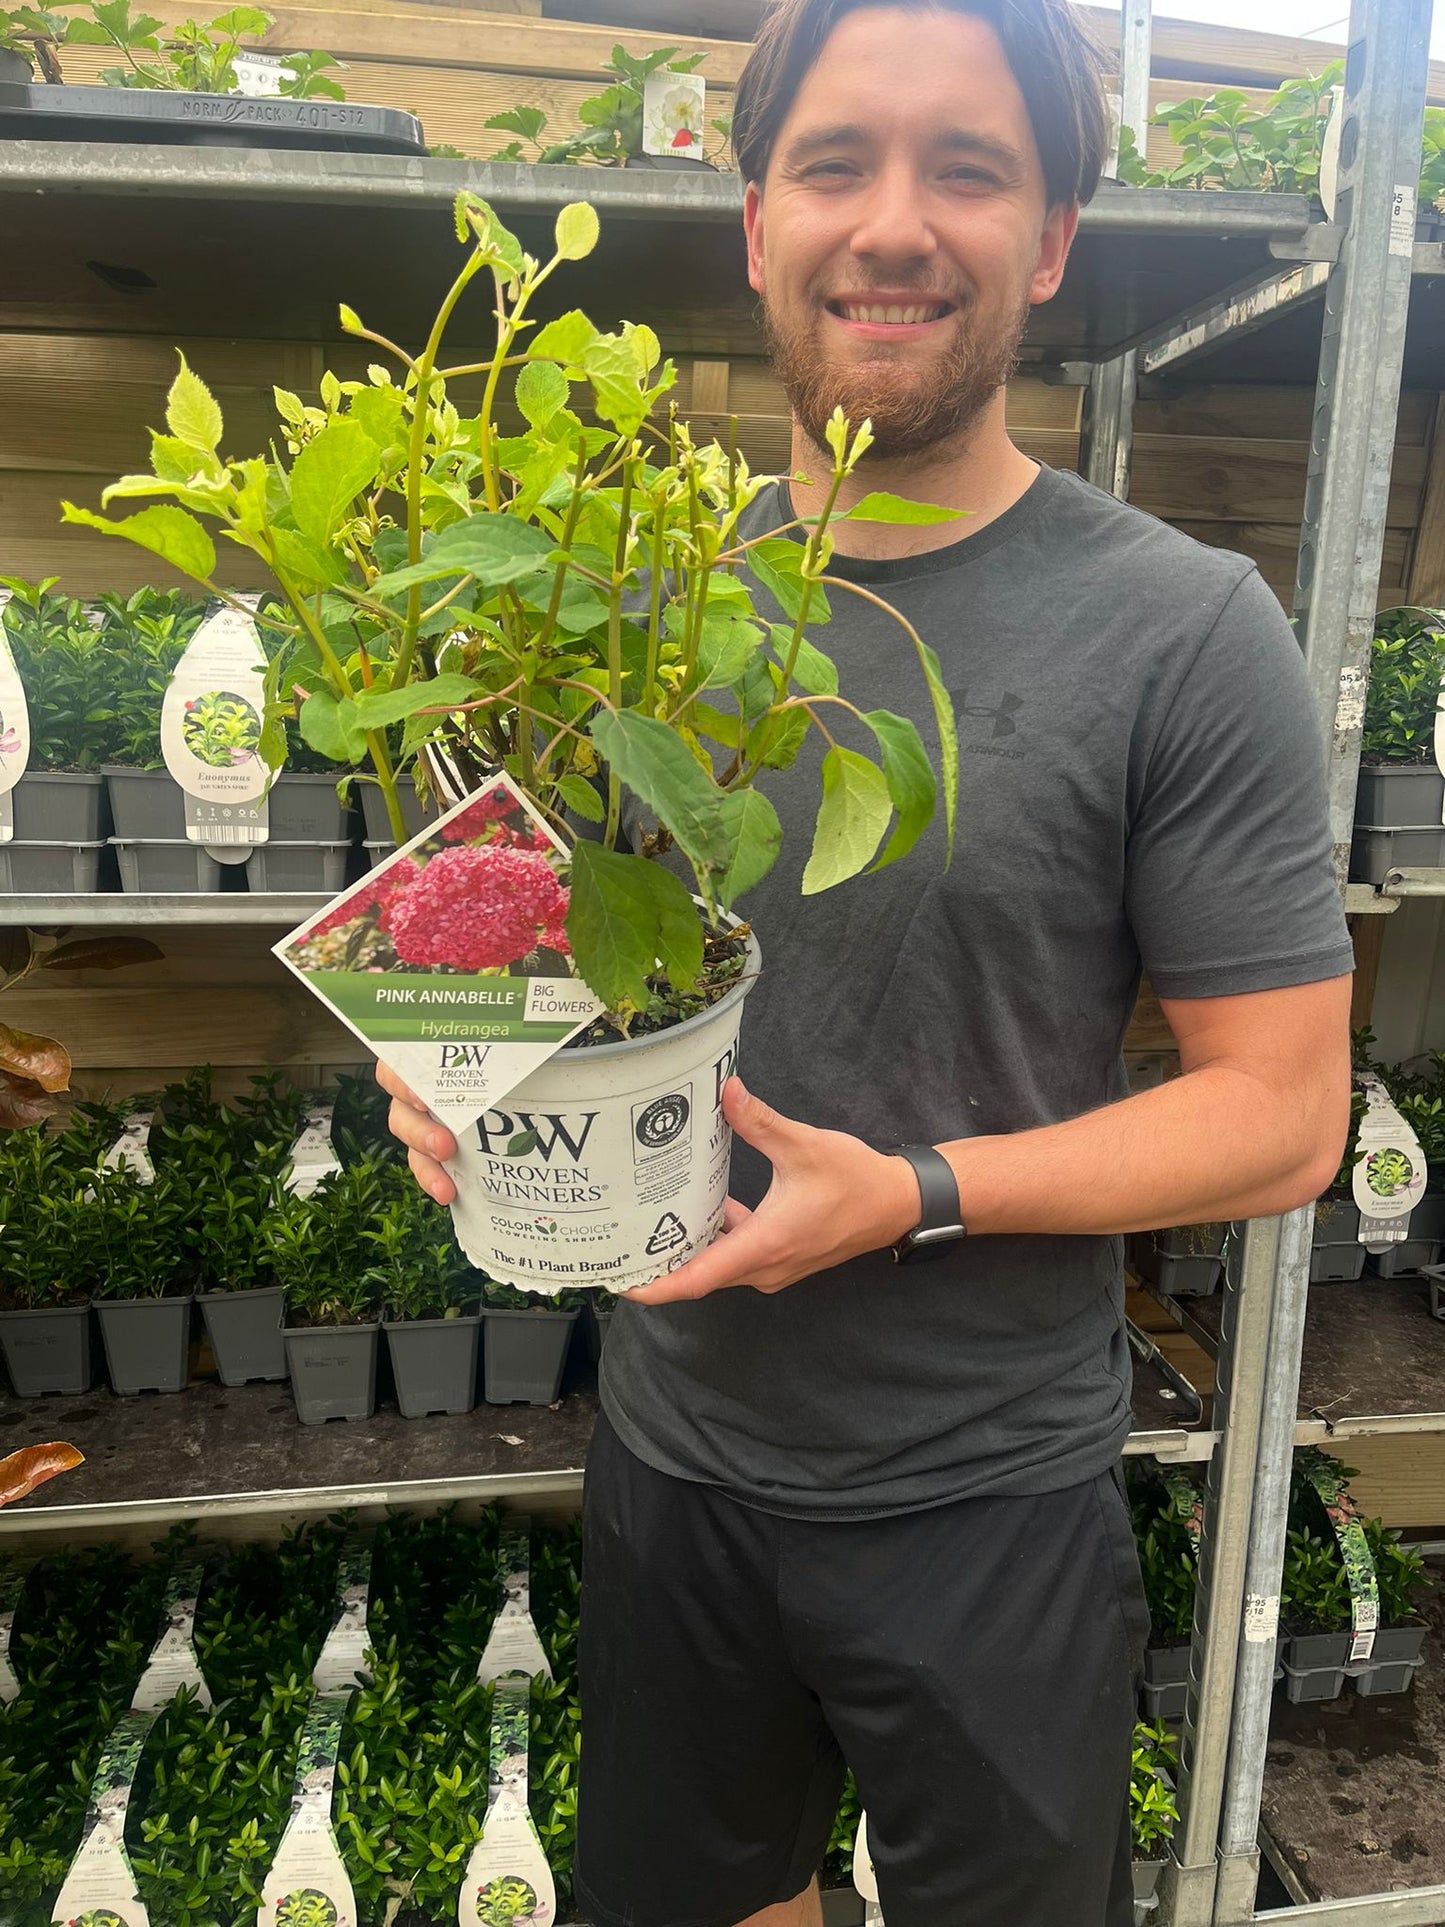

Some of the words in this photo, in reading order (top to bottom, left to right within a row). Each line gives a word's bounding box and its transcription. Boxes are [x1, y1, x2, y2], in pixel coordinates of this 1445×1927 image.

[183, 101, 222, 117] NORM
[248, 105, 283, 122] PACK
[197, 771, 251, 783] Euonymus
[375, 988, 417, 1004] PINK
[418, 989, 515, 1006] ANNABELLE
[533, 984, 555, 997] BIG
[531, 1000, 595, 1014] FLOWERS
[420, 1021, 511, 1040] Hydrangea
[438, 1044, 492, 1069] PW
[440, 1069, 485, 1079] PROVEN
[476, 1107, 601, 1163] PW
[486, 1159, 591, 1185] PROVEN
[490, 1215, 533, 1233] COLOR
[493, 1226, 557, 1243] FLOWERING
[565, 1234, 611, 1243] SHRUBS
[490, 1247, 516, 1266] The
[518, 1256, 534, 1269] #1
[538, 1259, 576, 1273] Plant
